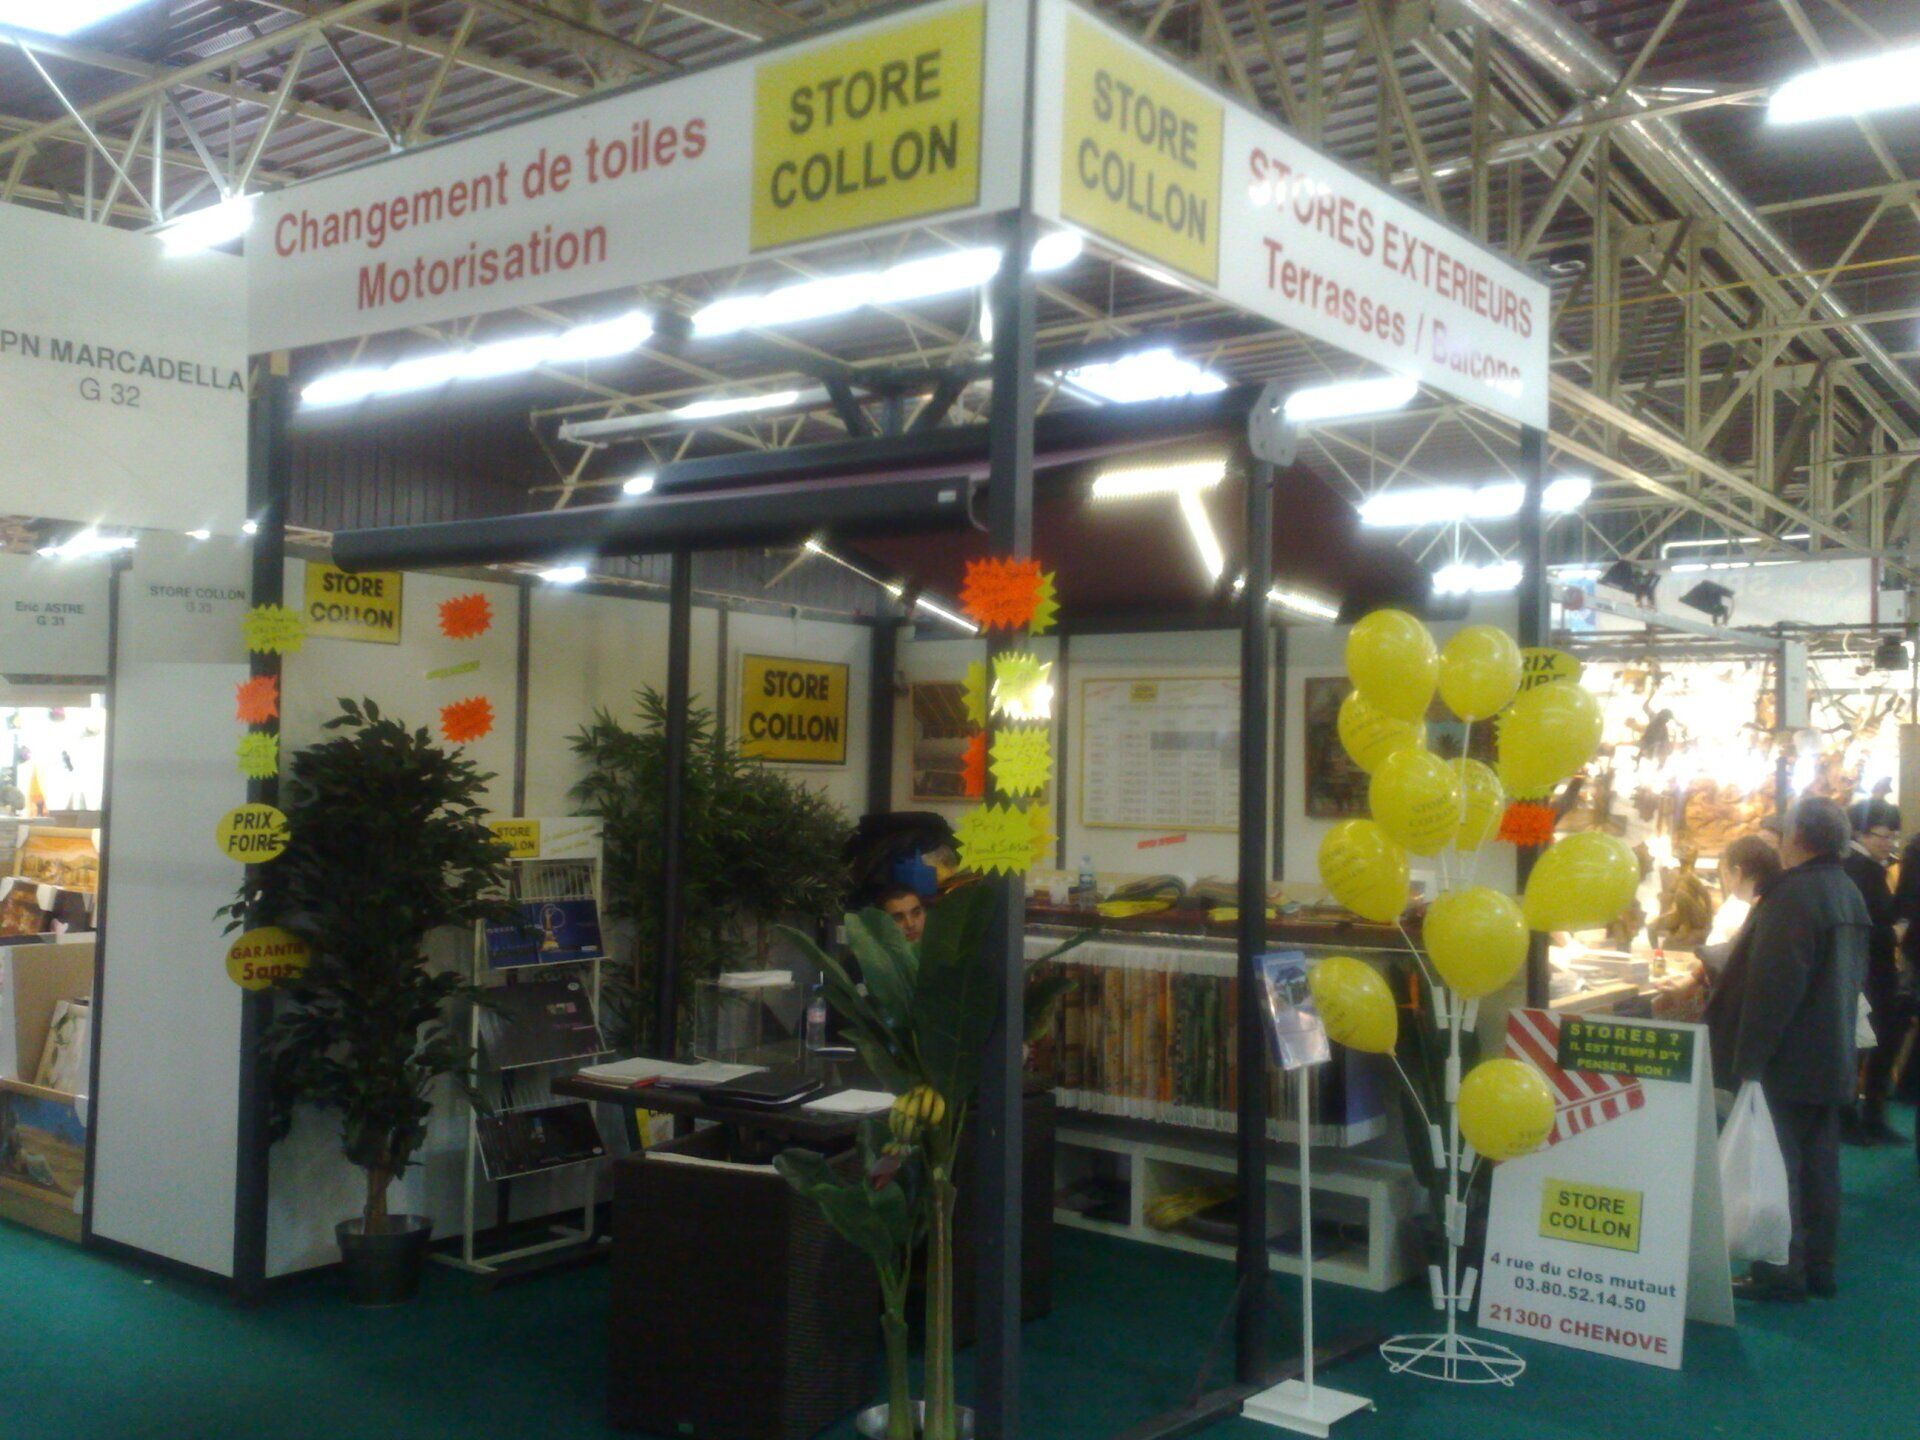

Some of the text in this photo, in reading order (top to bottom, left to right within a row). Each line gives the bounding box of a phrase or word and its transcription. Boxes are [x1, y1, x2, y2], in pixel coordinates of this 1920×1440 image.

[788, 49, 942, 136] STORE
[1093, 68, 1198, 171] STORE
[770, 119, 959, 209] COLLON
[274, 118, 708, 257] Changement de toiles
[1078, 137, 1208, 244] COLLON
[1250, 147, 1533, 339] STORES EXTERIEURS
[358, 224, 608, 311] Motorisation
[1263, 236, 1406, 347] Terrasses
[50, 338, 244, 392] MARCADELLA
[79, 377, 140, 407] G 32
[149, 585, 245, 600] STORE COLLON
[323, 571, 384, 598] STORE
[44, 602, 84, 614] ASTRE
[1522, 653, 1559, 671] RIX
[763, 669, 829, 700] STORE
[748, 711, 839, 743] COLLON
[233, 811, 273, 831] PRIX
[497, 826, 531, 838] STORE
[228, 834, 278, 852] FOIRE
[1569, 1023, 1657, 1044] STORES
[1584, 1043, 1609, 1054] EST
[1613, 1045, 1656, 1059] TEMPS
[1559, 1190, 1625, 1215] STORE
[1549, 1211, 1631, 1239] COLLON
[1490, 1251, 1677, 1298] 4 rue du clos mutaut
[1514, 1275, 1646, 1313] 03.80.52.14.50
[1489, 1303, 1668, 1355] 21300 CHENOVE
